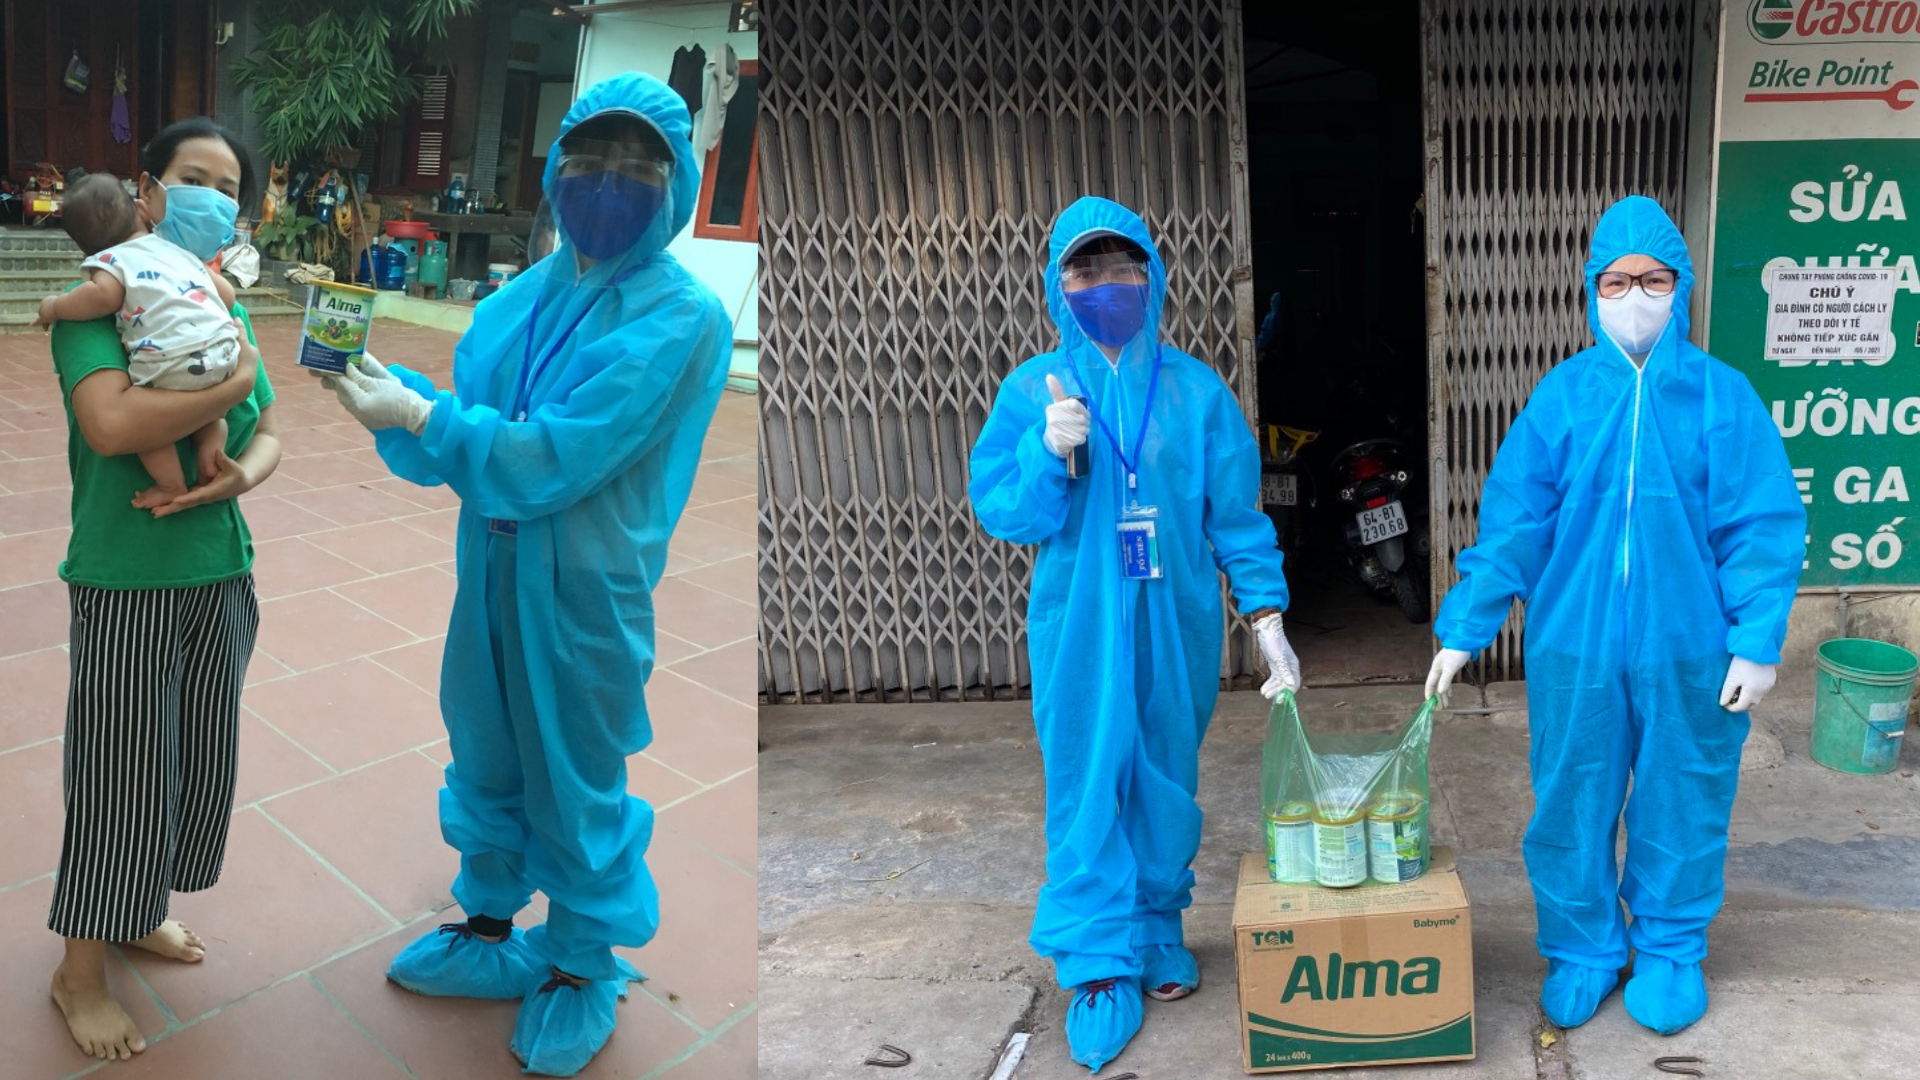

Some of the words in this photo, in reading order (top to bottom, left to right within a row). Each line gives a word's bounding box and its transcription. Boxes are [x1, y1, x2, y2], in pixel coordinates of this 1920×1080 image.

[1796, 0, 1920, 36] Castro
[1748, 60, 1810, 88] Bike
[1816, 58, 1893, 86] Point
[1789, 165, 1907, 223] SỬA
[1809, 285, 1841, 298] CHÚ
[1846, 285, 1855, 298] Ý
[326, 297, 362, 314] Alma
[1775, 303, 1789, 313] GIA
[1813, 301, 1824, 313] CÓ
[1853, 301, 1875, 313] CÁCH
[1877, 303, 1887, 313] LY
[1798, 318, 1821, 328] THEO
[1842, 318, 1848, 328] Y
[1850, 314, 1861, 328] TẾ
[1777, 332, 1811, 342] KHÔNG
[1813, 331, 1835, 342] TIẾP
[1772, 387, 1920, 438] ƯỠNG
[1833, 466, 1910, 504] GA
[1363, 505, 1395, 526] 64-B1
[1363, 517, 1405, 542] 230.68
[1829, 516, 1906, 570] SỐ
[1280, 952, 1441, 1004] Alma
[1265, 1053, 1276, 1062] 24
[1291, 1051, 1306, 1060] 400
